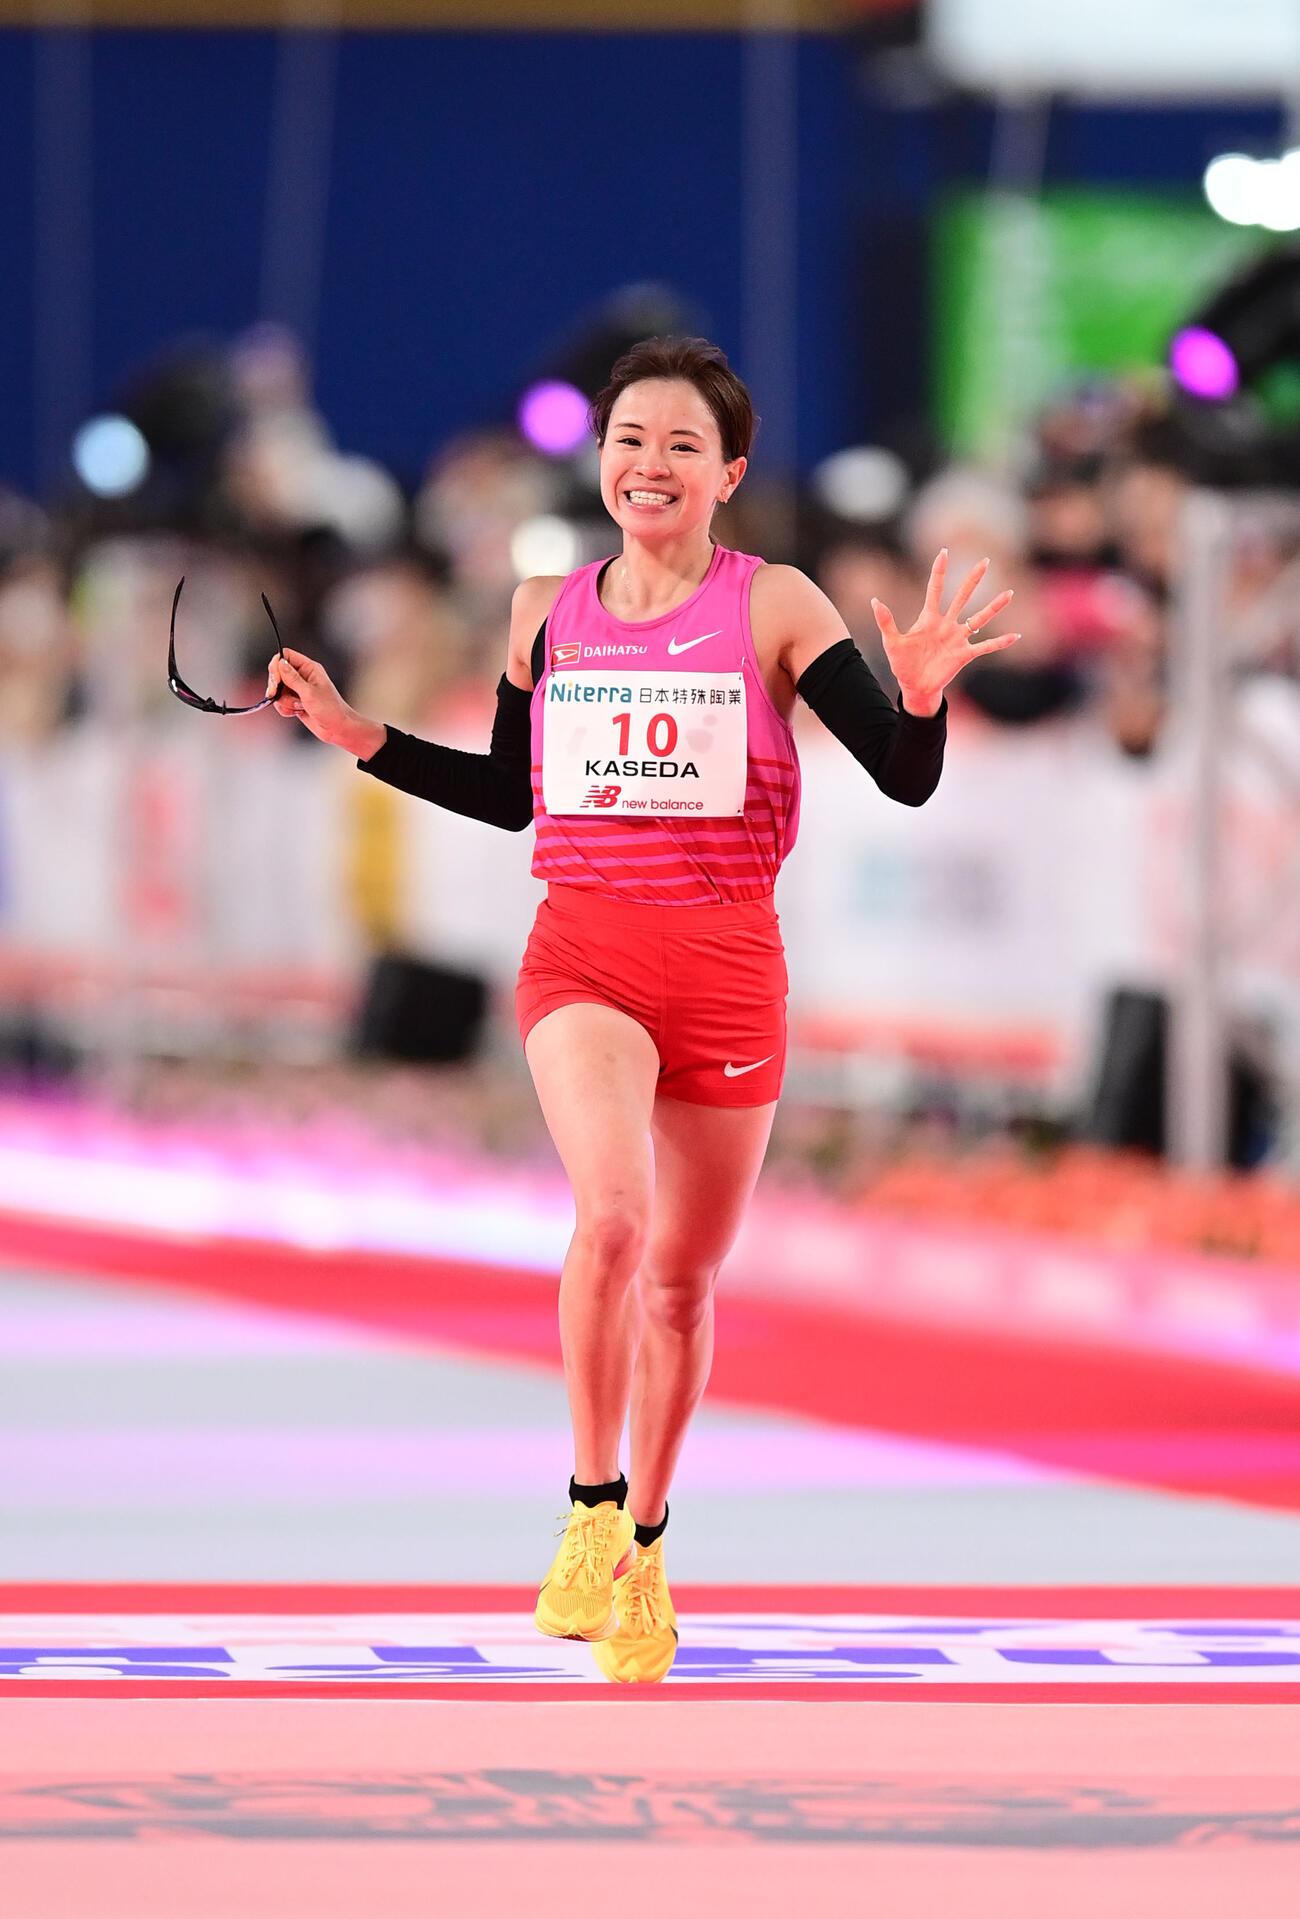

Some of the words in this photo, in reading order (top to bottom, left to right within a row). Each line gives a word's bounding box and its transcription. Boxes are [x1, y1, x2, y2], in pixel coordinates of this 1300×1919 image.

[583, 645, 648, 658] DAIHATSU
[550, 682, 632, 703] Niterra
[639, 687, 742, 706] 日本特殊陶業
[612, 712, 678, 758] 10
[585, 760, 700, 778] KASEDA
[621, 799, 648, 809] new
[650, 798, 704, 811] balance
